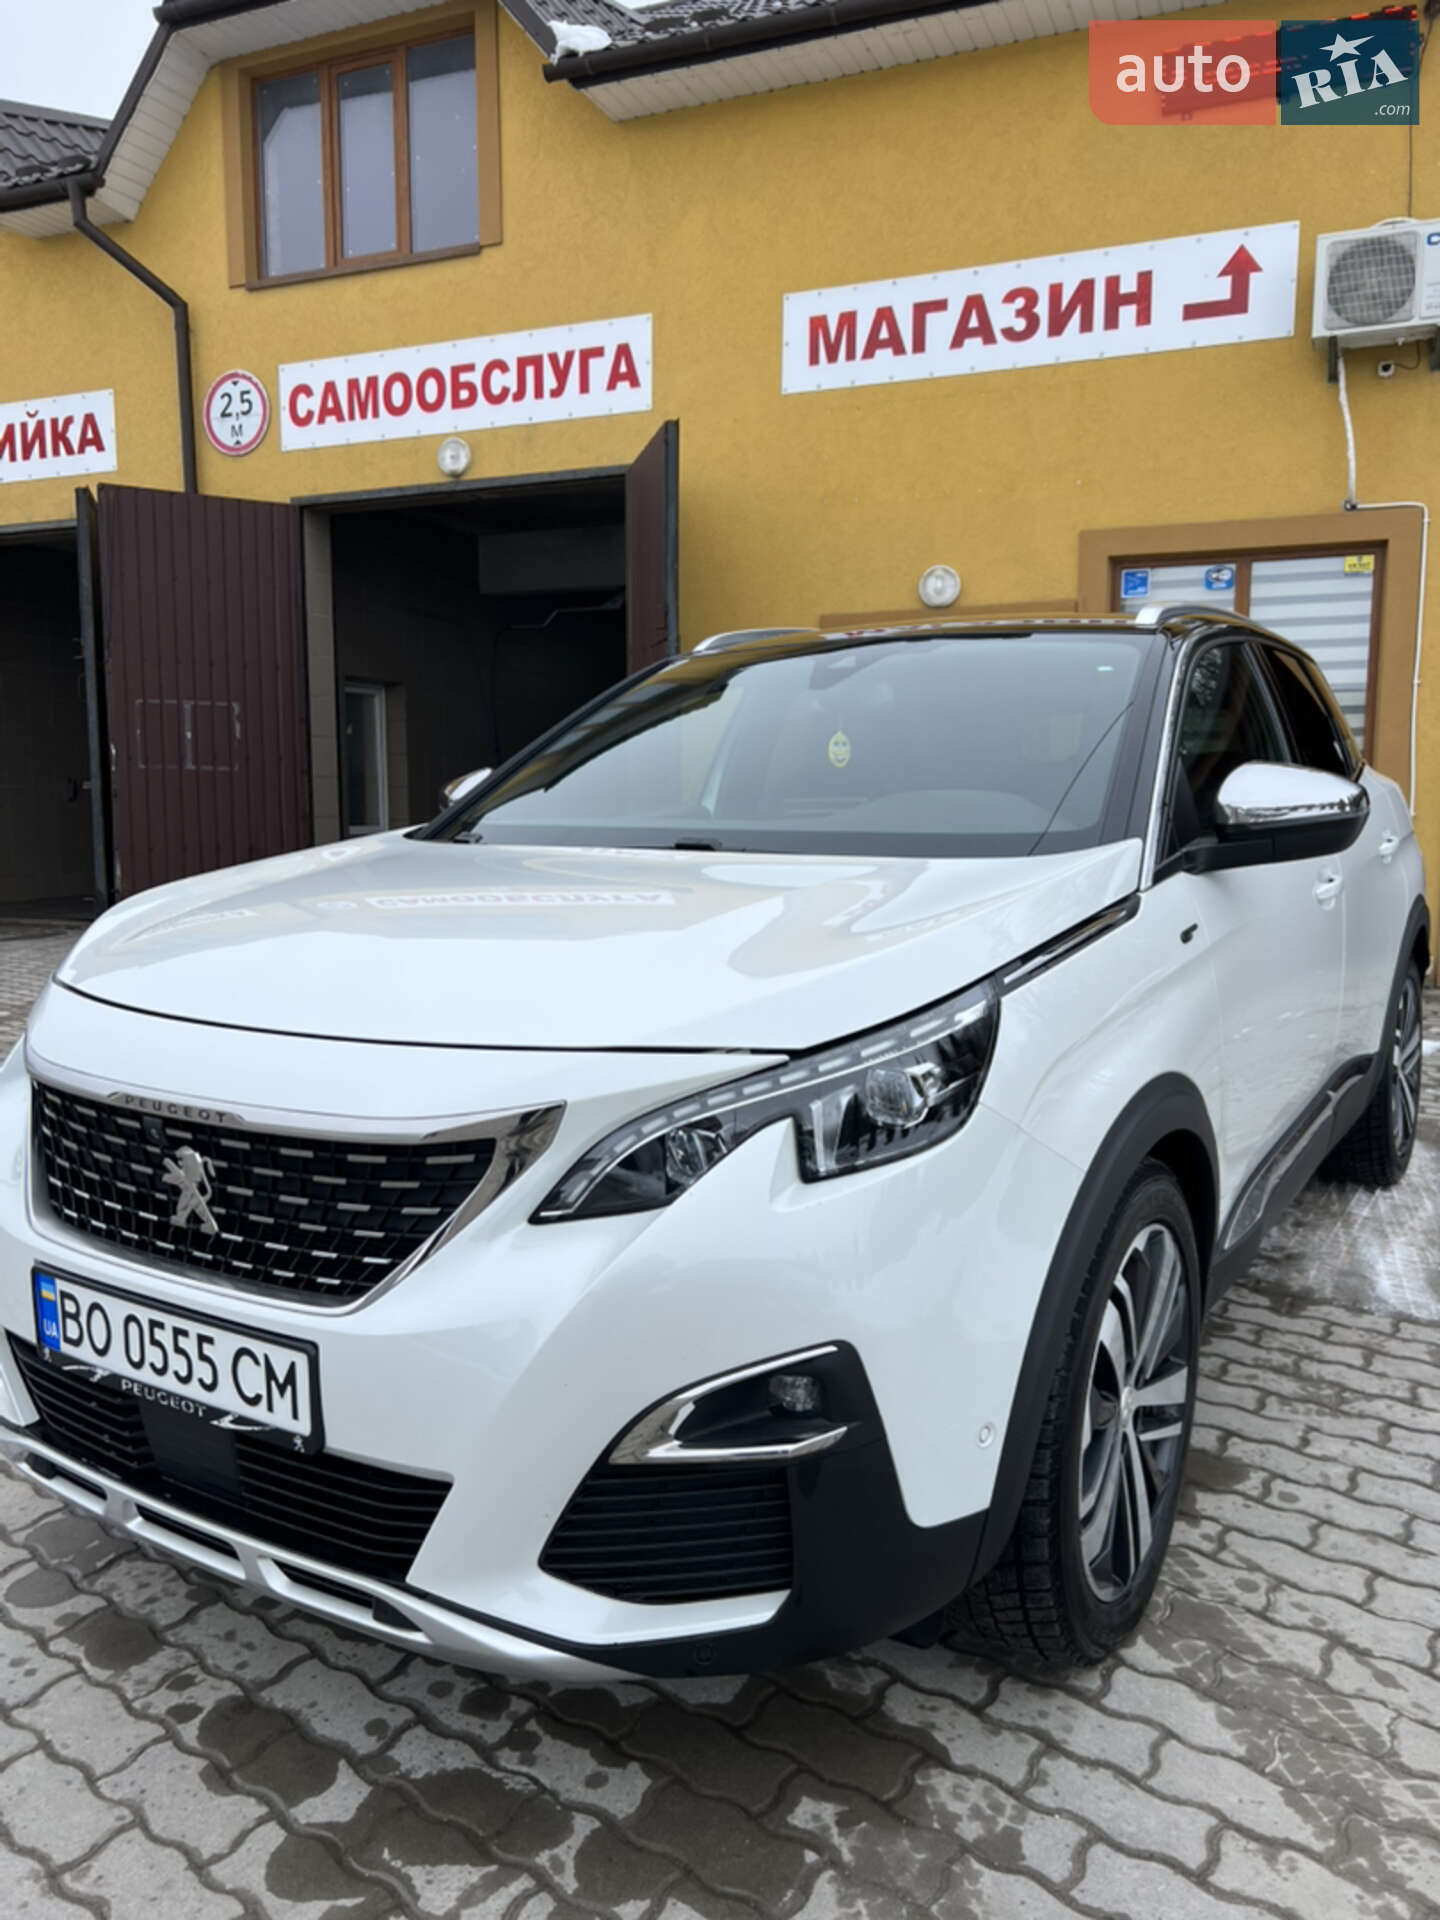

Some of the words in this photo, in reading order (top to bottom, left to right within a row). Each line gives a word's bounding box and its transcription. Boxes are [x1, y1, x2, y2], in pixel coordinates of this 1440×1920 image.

[808, 269, 1154, 367] МАГАЗИН
[220, 389, 254, 421] 2,5
[287, 342, 642, 428] САМООБСЛУГА
[124, 1093, 226, 1123] PEUGEOT
[59, 1289, 113, 1358] BO
[123, 1313, 220, 1393] 0555
[230, 1346, 300, 1422] CM
[121, 1379, 207, 1418] PEUGEOT
